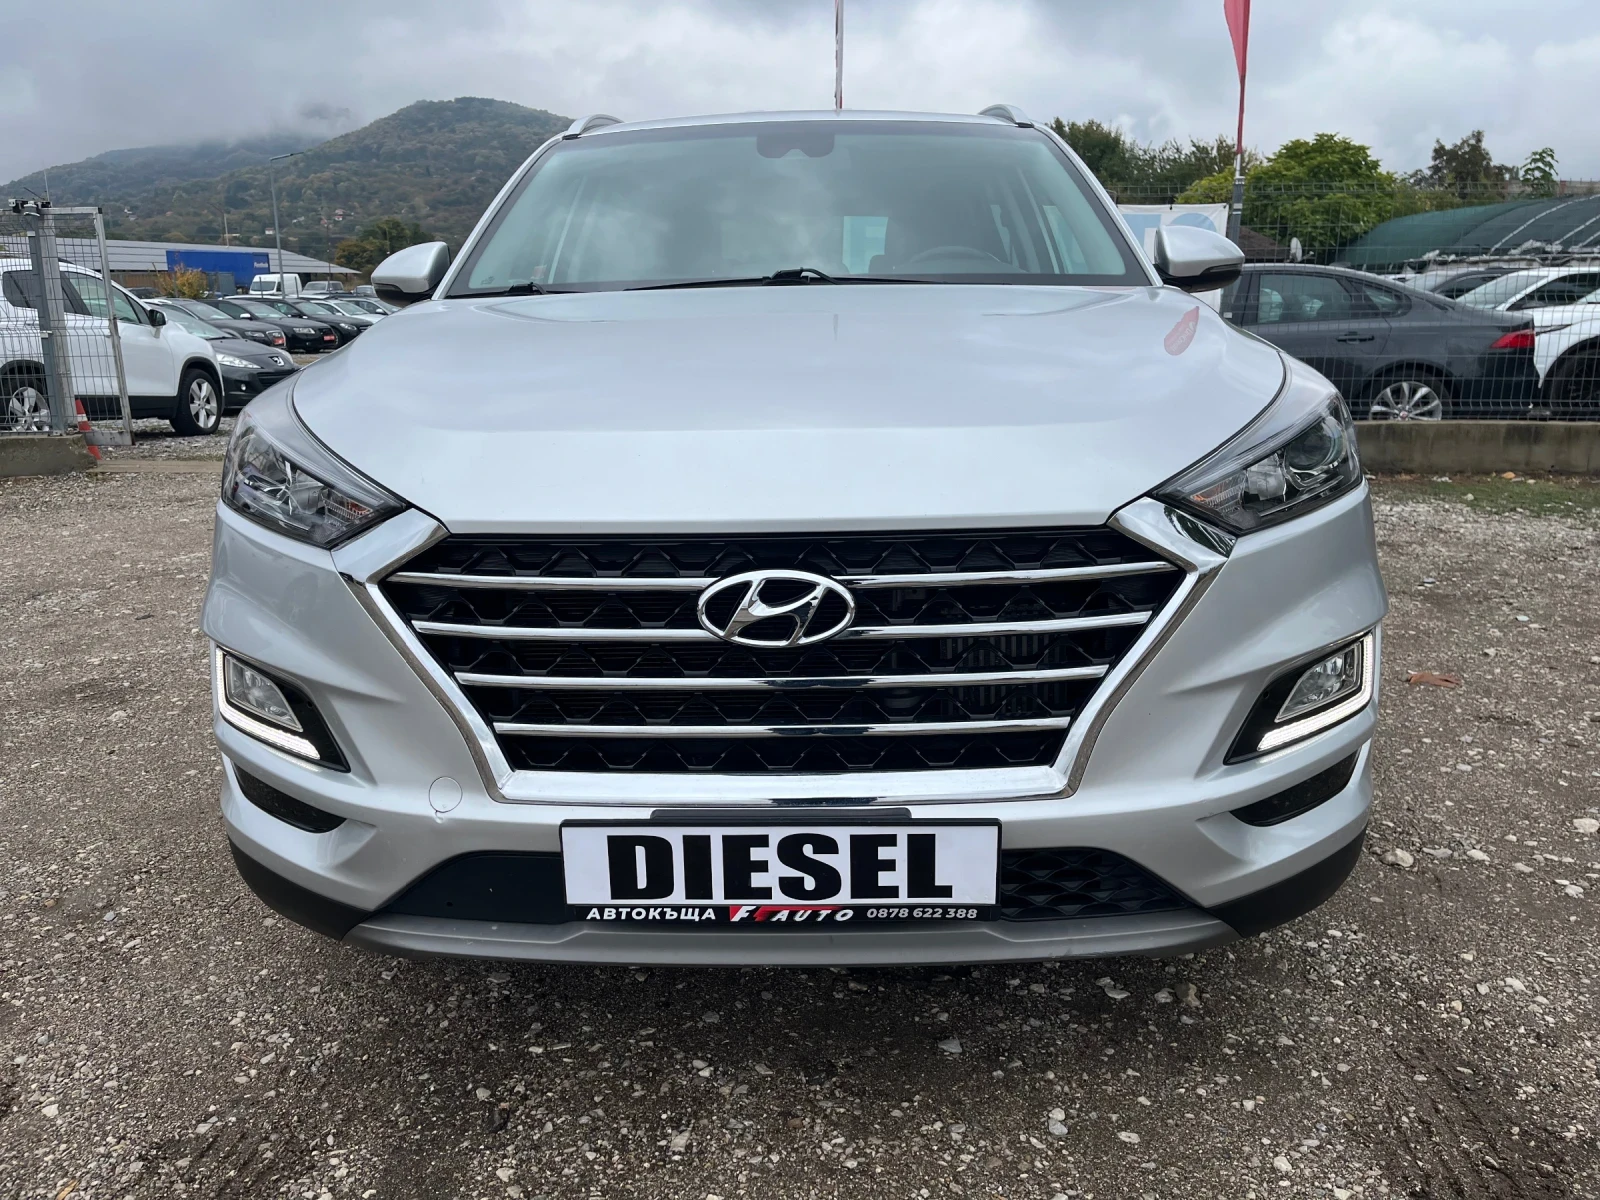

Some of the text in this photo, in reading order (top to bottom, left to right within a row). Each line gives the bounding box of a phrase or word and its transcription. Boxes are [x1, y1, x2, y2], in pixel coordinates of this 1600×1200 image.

[607, 833, 953, 901] DIESEL
[586, 907, 716, 922] АВТОКЪЩА
[770, 909, 854, 922] AUTO
[866, 908, 909, 919] 0878
[912, 908, 943, 918] 622
[945, 908, 978, 919] 388
